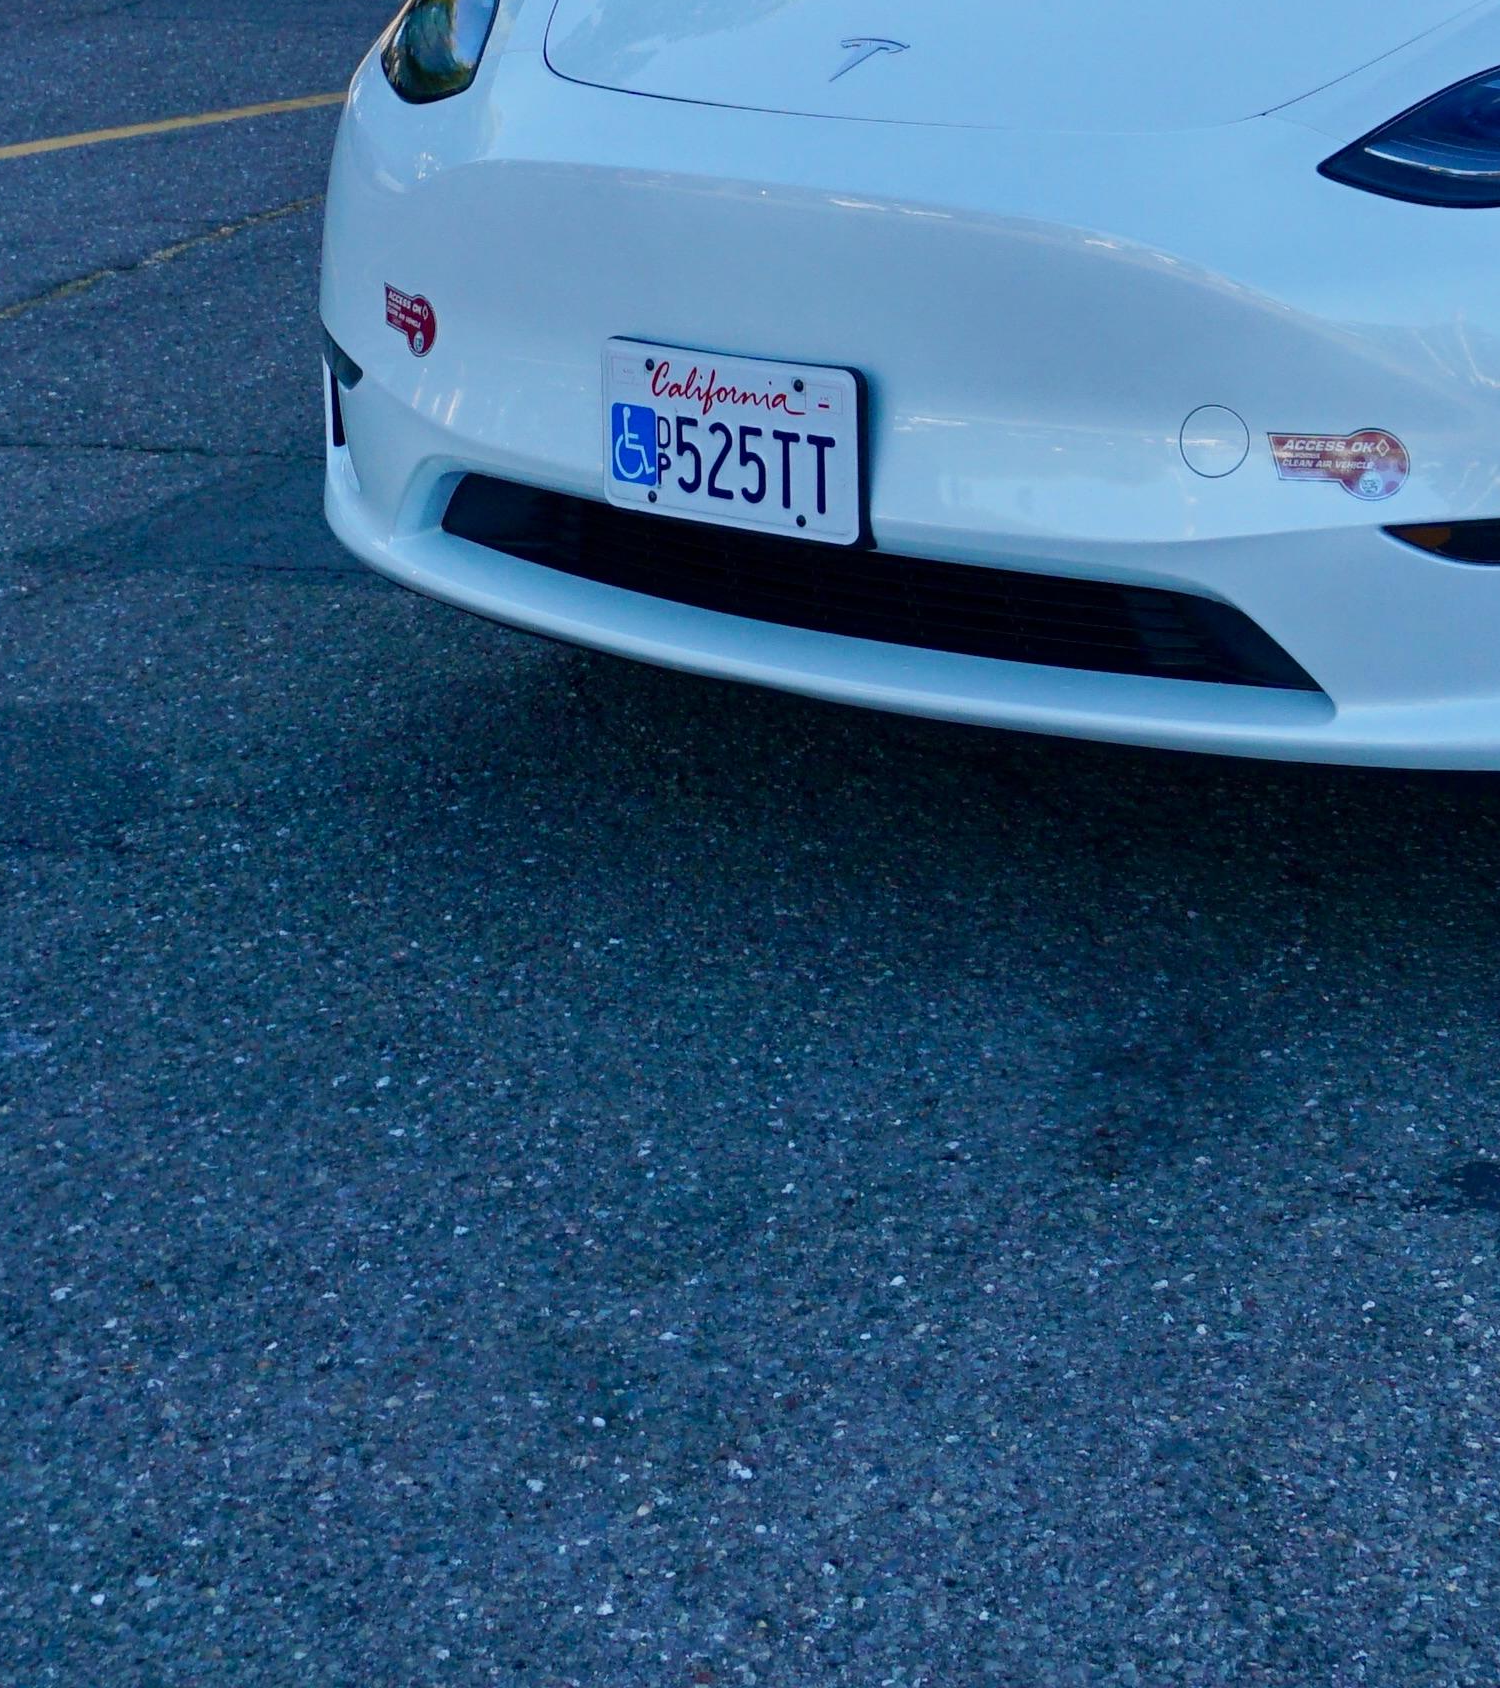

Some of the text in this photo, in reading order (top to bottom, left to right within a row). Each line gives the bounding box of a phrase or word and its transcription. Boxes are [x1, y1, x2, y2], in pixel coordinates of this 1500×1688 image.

[388, 291, 412, 309] ACCESS
[412, 303, 422, 316] OK
[651, 361, 805, 415] California
[1282, 439, 1375, 453] ACCESS OK
[1282, 458, 1375, 470] CLEAN AIR VEHICLE
